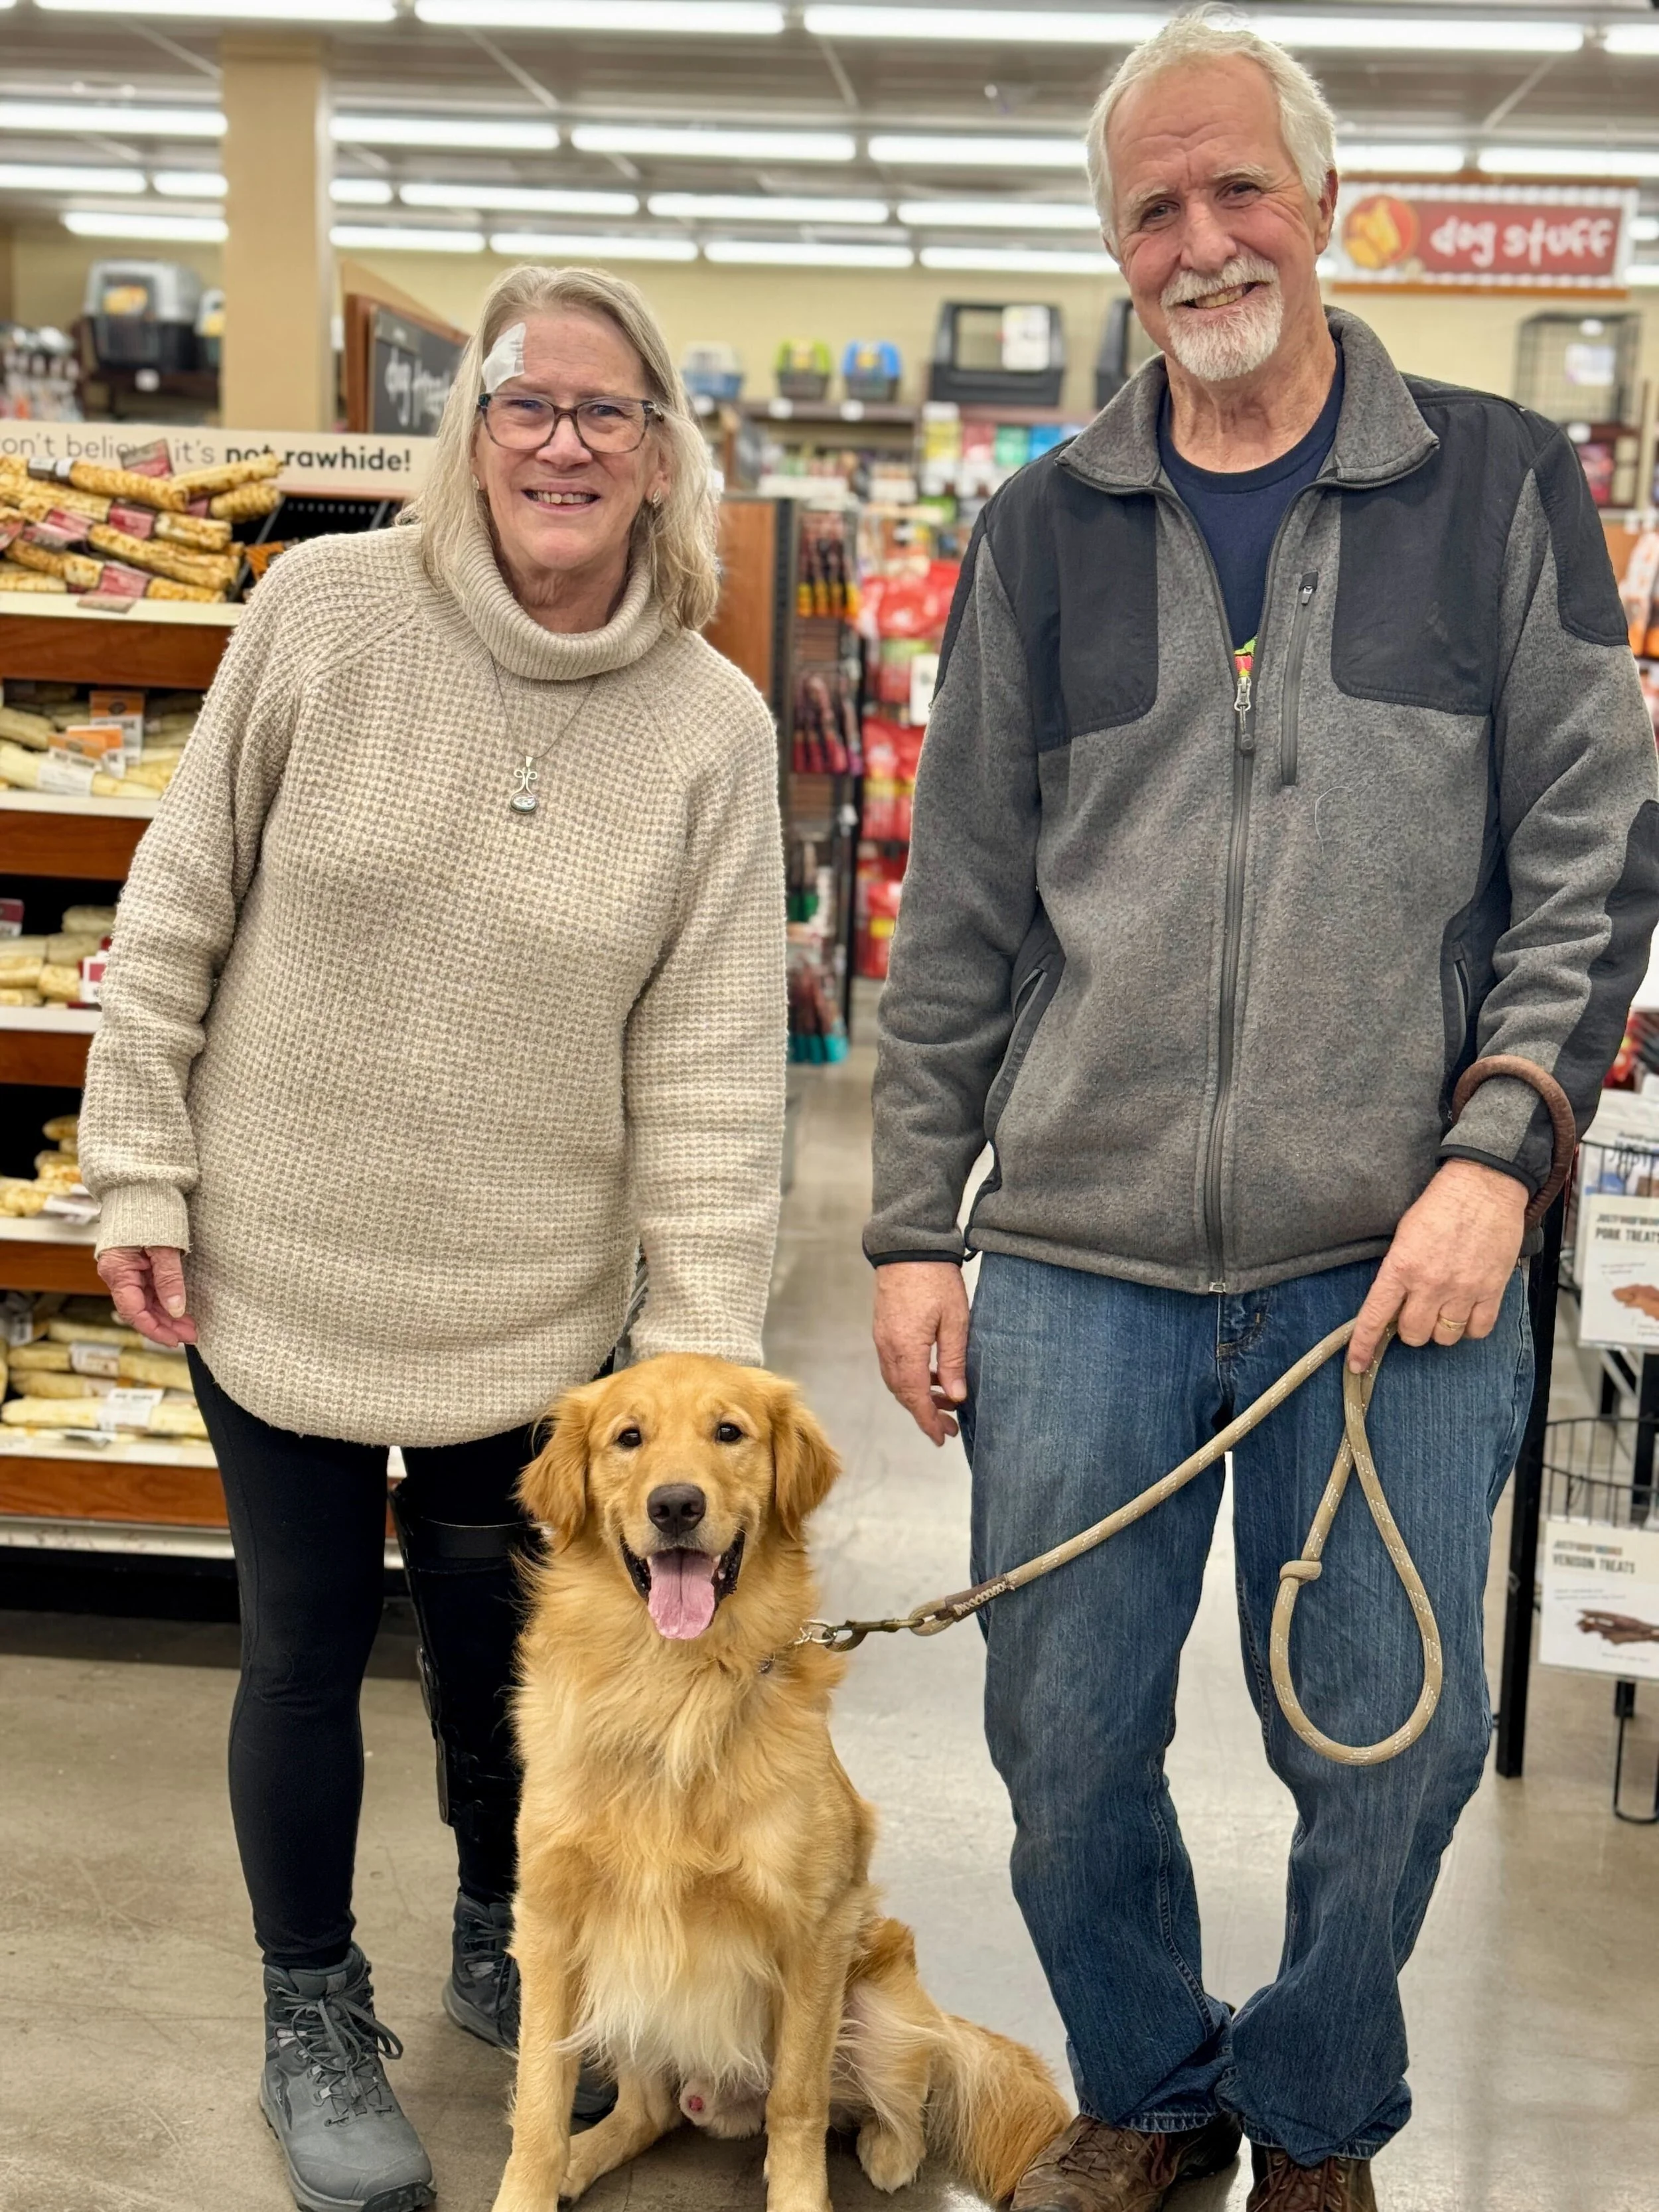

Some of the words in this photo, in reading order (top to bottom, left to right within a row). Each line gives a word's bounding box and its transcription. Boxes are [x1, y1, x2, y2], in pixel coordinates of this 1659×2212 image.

[1430, 215, 1496, 267] dog
[1502, 217, 1614, 267] stuff
[1, 433, 54, 458] on't
[175, 438, 214, 464] it's
[285, 445, 411, 472] rawhide!
[1600, 1558, 1636, 1574] TREATS
